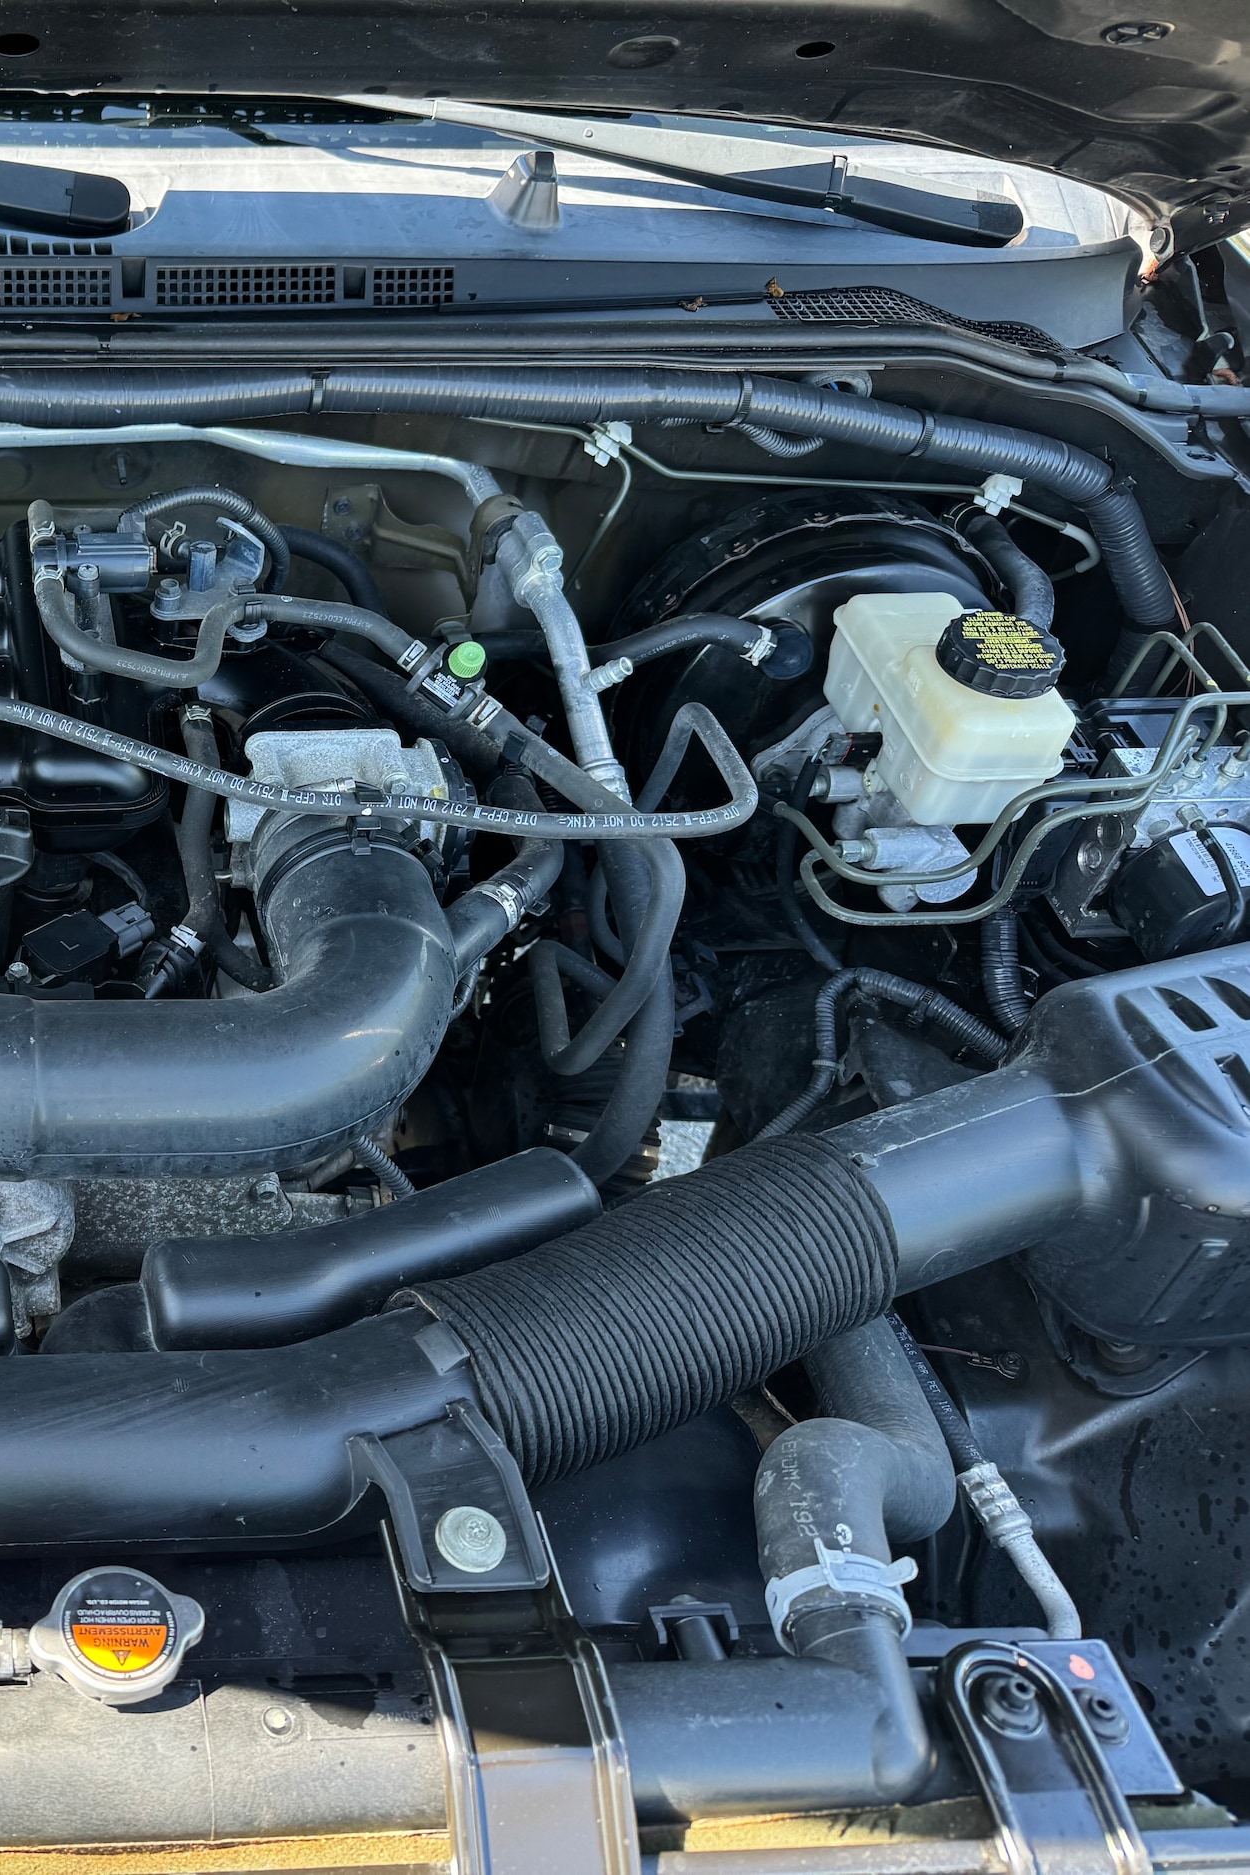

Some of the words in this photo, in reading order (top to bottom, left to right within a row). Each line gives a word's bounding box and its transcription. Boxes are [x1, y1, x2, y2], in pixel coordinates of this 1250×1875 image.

[37, 712, 56, 728] NOT
[58, 719, 73, 733] DO
[75, 724, 100, 743] 7512
[137, 745, 158, 762] DTR
[205, 769, 227, 784] NOT
[230, 777, 245, 792] DO
[248, 782, 275, 800] 7512
[398, 796, 417, 809] NOT
[423, 799, 437, 812] DO
[441, 802, 468, 817] 7512
[515, 812, 538, 826] DTR
[724, 805, 740, 821] DTR
[602, 815, 624, 827] NOT
[630, 815, 645, 827] DO
[652, 815, 679, 827] 7512
[915, 1361, 929, 1376] NBR
[927, 1380, 941, 1394] PET
[78, 1628, 161, 1636] AVERTISSEMENT
[94, 1638, 149, 1647] WARNING
